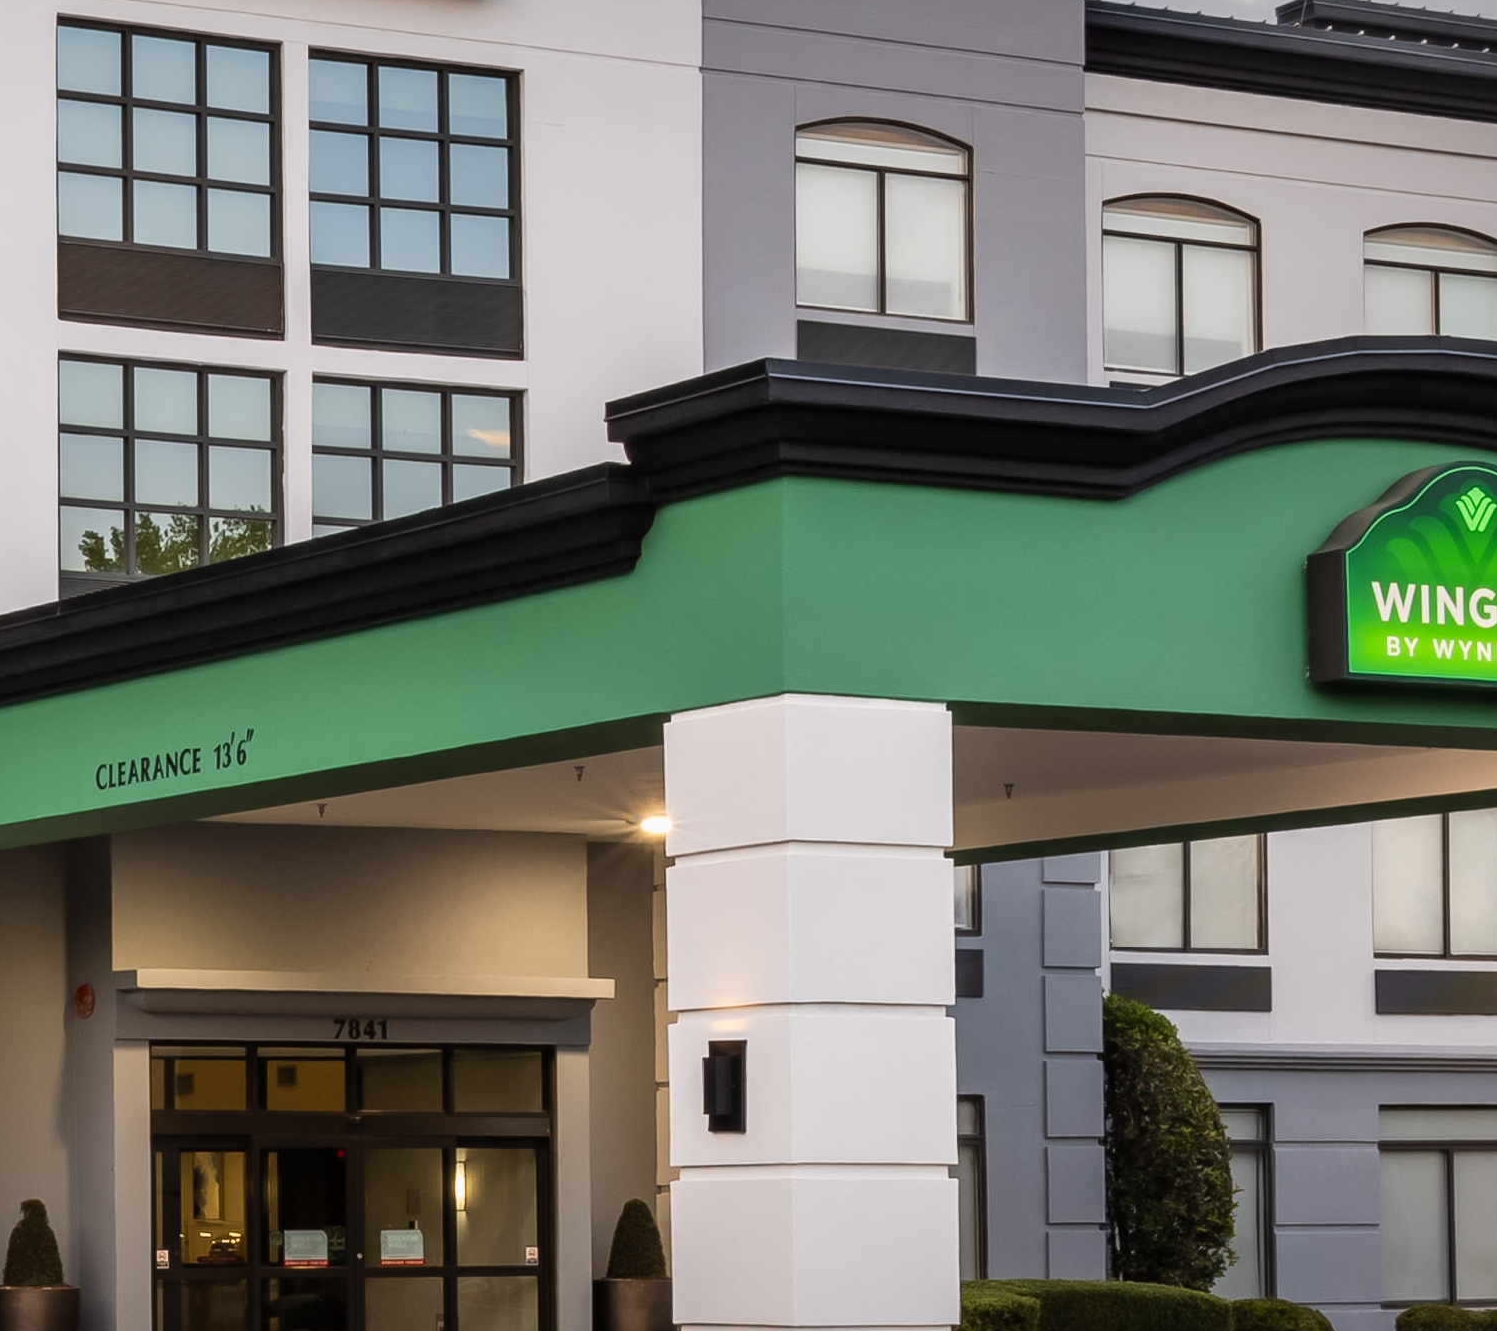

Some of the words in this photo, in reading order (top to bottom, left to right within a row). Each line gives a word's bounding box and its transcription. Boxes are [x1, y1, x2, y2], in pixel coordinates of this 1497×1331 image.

[1386, 635, 1419, 657] BY
[95, 747, 202, 790] CLEARANCE
[332, 1018, 388, 1040] 7841
